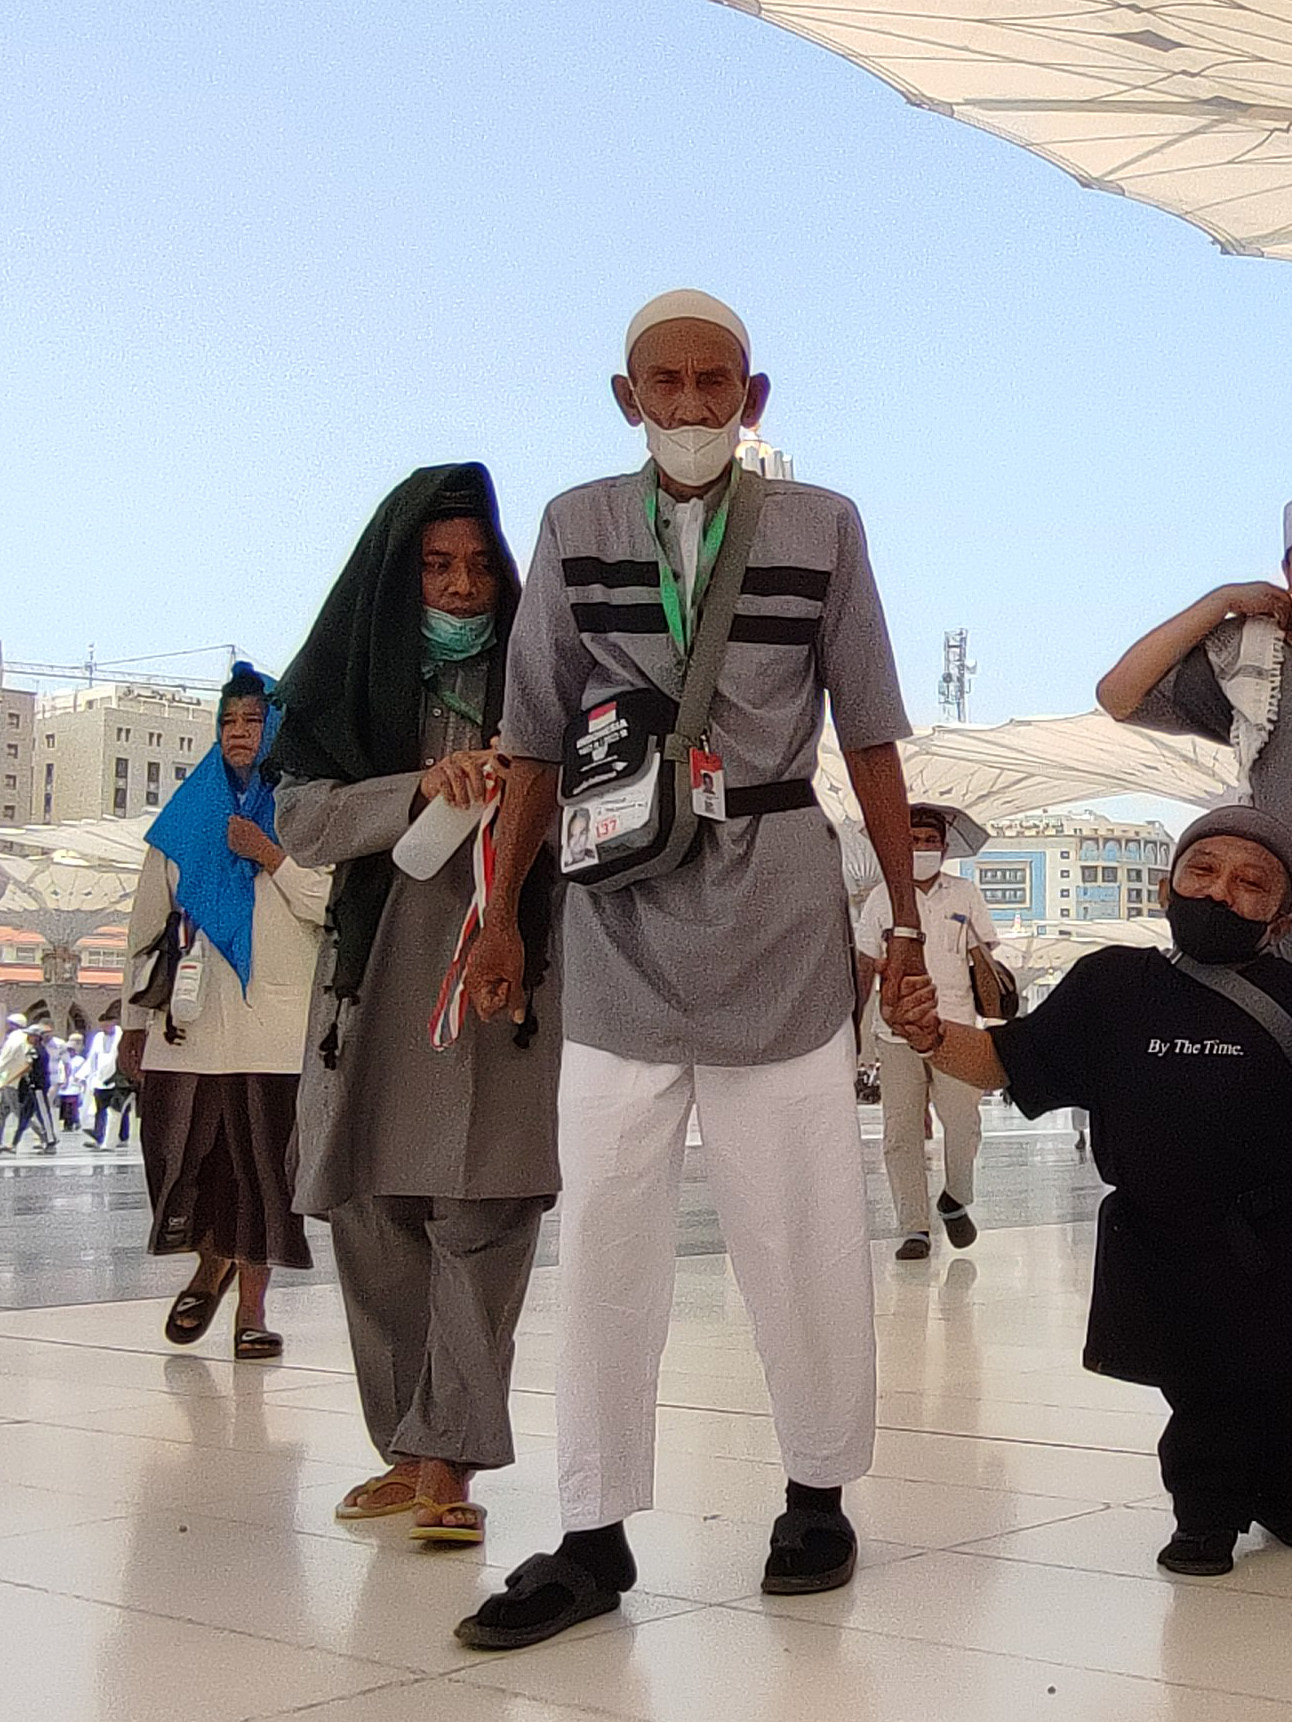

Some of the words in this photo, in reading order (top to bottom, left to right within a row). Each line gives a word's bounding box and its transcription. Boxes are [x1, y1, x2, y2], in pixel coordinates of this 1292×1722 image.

[596, 819, 616, 838] 137
[1147, 1039, 1170, 1057] By
[1174, 1039, 1201, 1054] The
[1203, 1040, 1244, 1056] Time.
